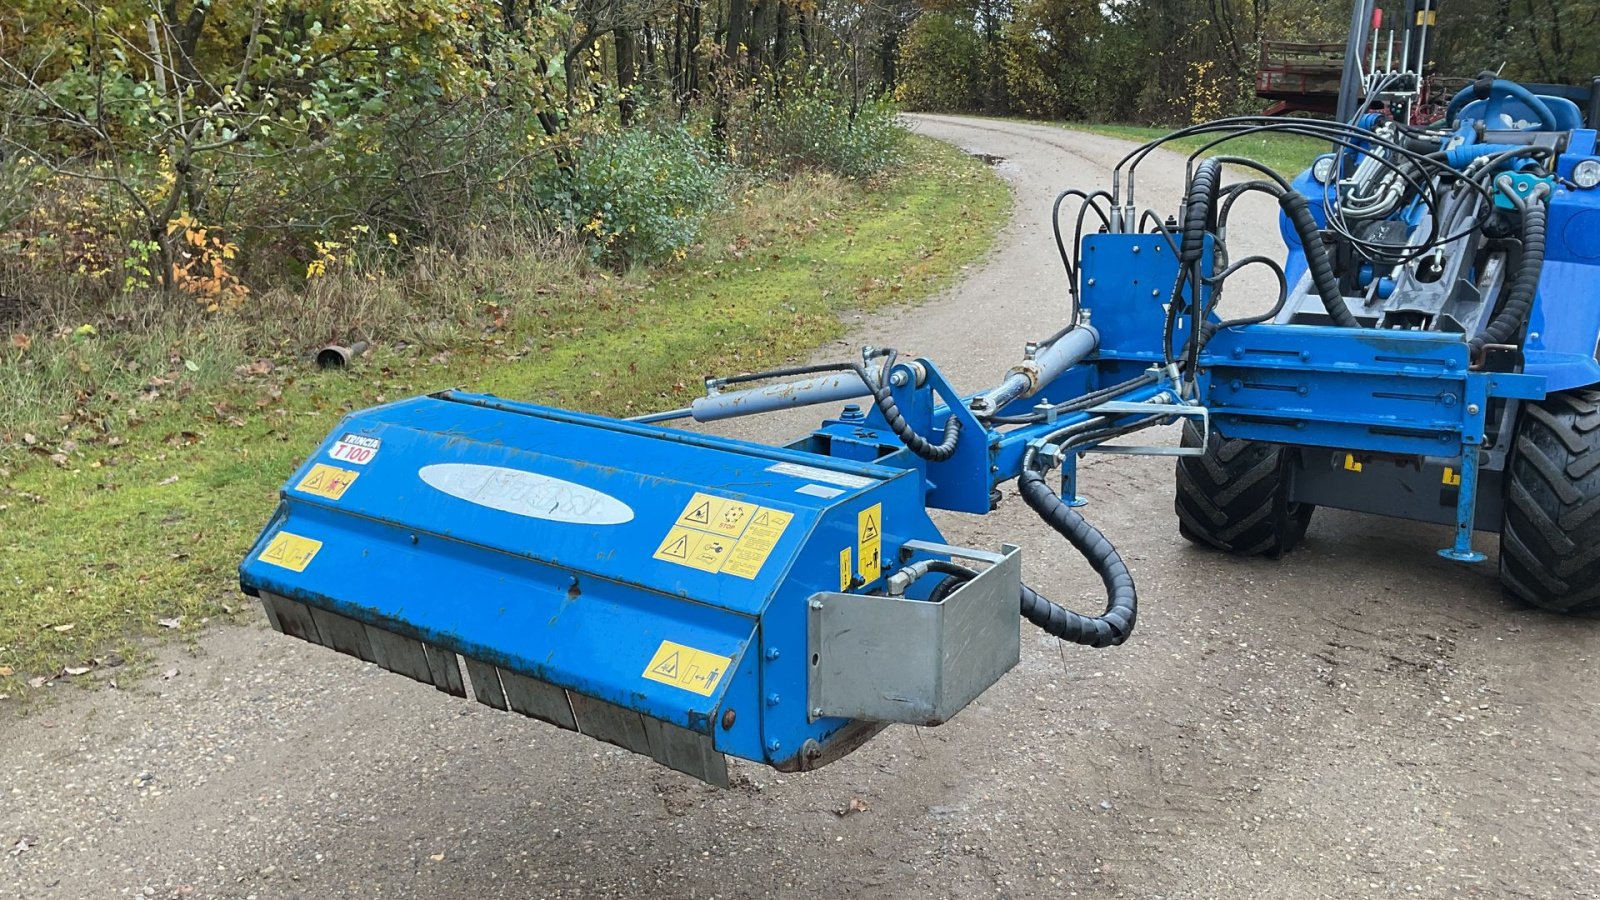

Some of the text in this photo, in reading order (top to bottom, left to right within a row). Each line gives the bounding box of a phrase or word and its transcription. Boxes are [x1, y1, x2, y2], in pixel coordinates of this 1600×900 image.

[344, 434, 380, 449] TRINCIA
[335, 444, 371, 462] T 100
[718, 522, 736, 530] STOP
